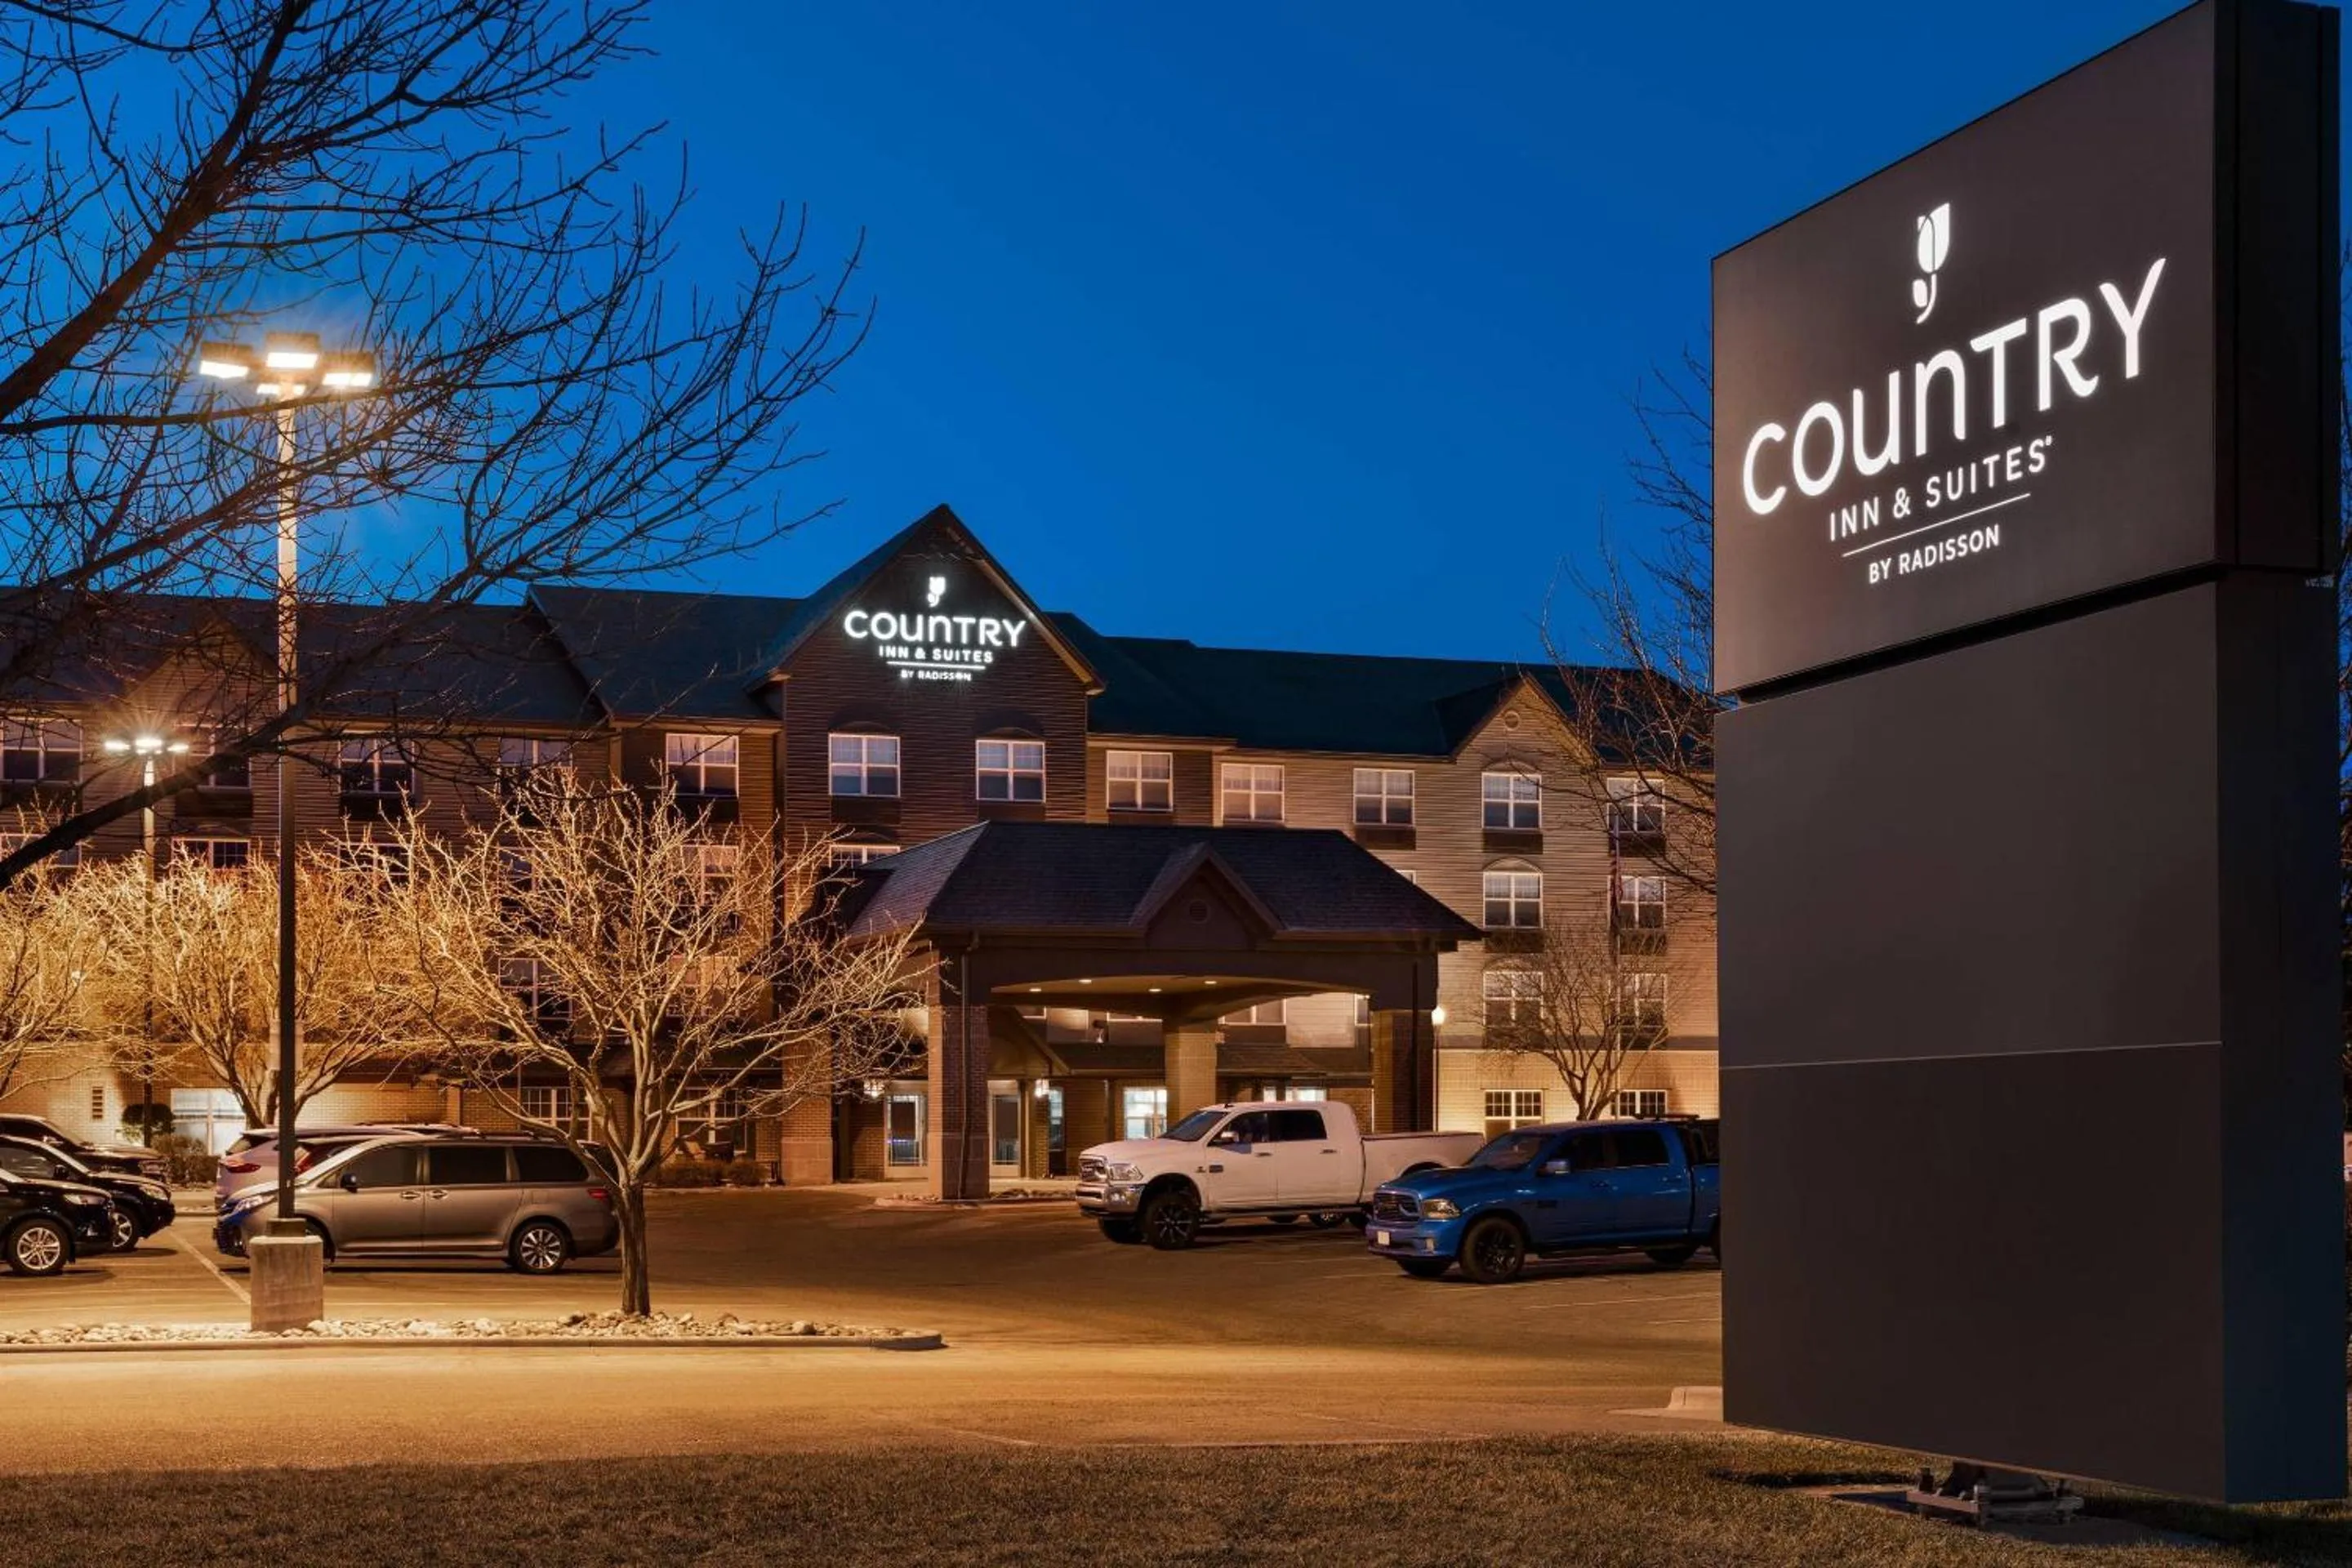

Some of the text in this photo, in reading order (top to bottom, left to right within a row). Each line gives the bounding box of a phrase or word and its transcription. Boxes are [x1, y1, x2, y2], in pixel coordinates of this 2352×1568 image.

[1742, 257, 2167, 516] COUNTRY
[1830, 497, 1879, 541] INN
[1892, 487, 1912, 519] &
[1869, 524, 2000, 584] BY RADISSON
[844, 610, 1027, 648] COUNTRY
[879, 645, 993, 663] INN & SUITES
[901, 669, 972, 681] BY RADISSON
